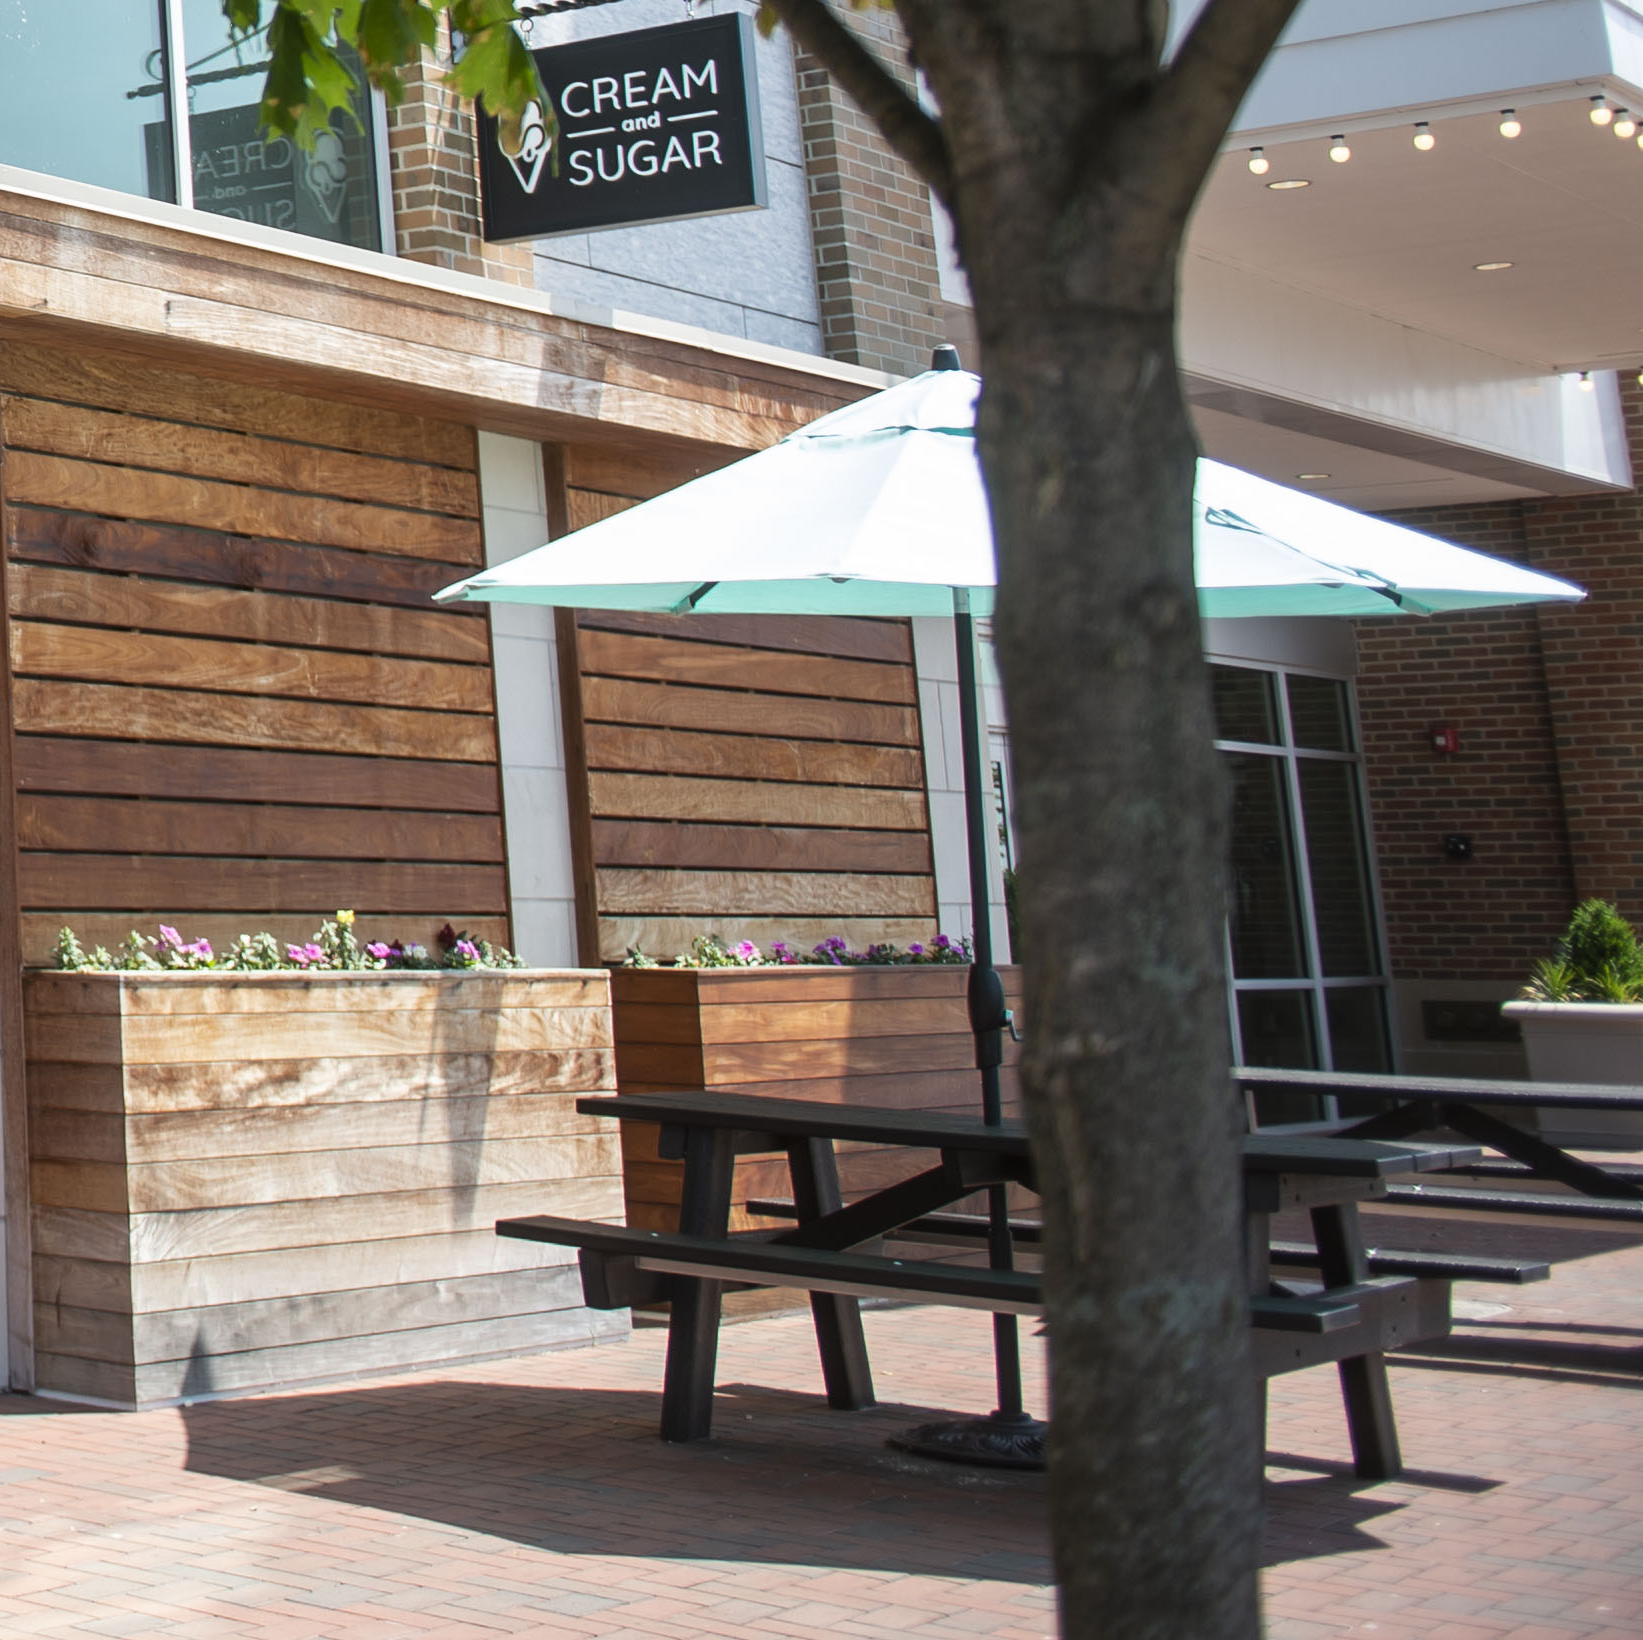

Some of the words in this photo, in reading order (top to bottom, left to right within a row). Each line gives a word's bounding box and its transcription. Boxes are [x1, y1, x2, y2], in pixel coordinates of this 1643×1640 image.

[561, 59, 719, 118] CREAM
[621, 111, 661, 133] and
[569, 130, 723, 186] SUGAR
